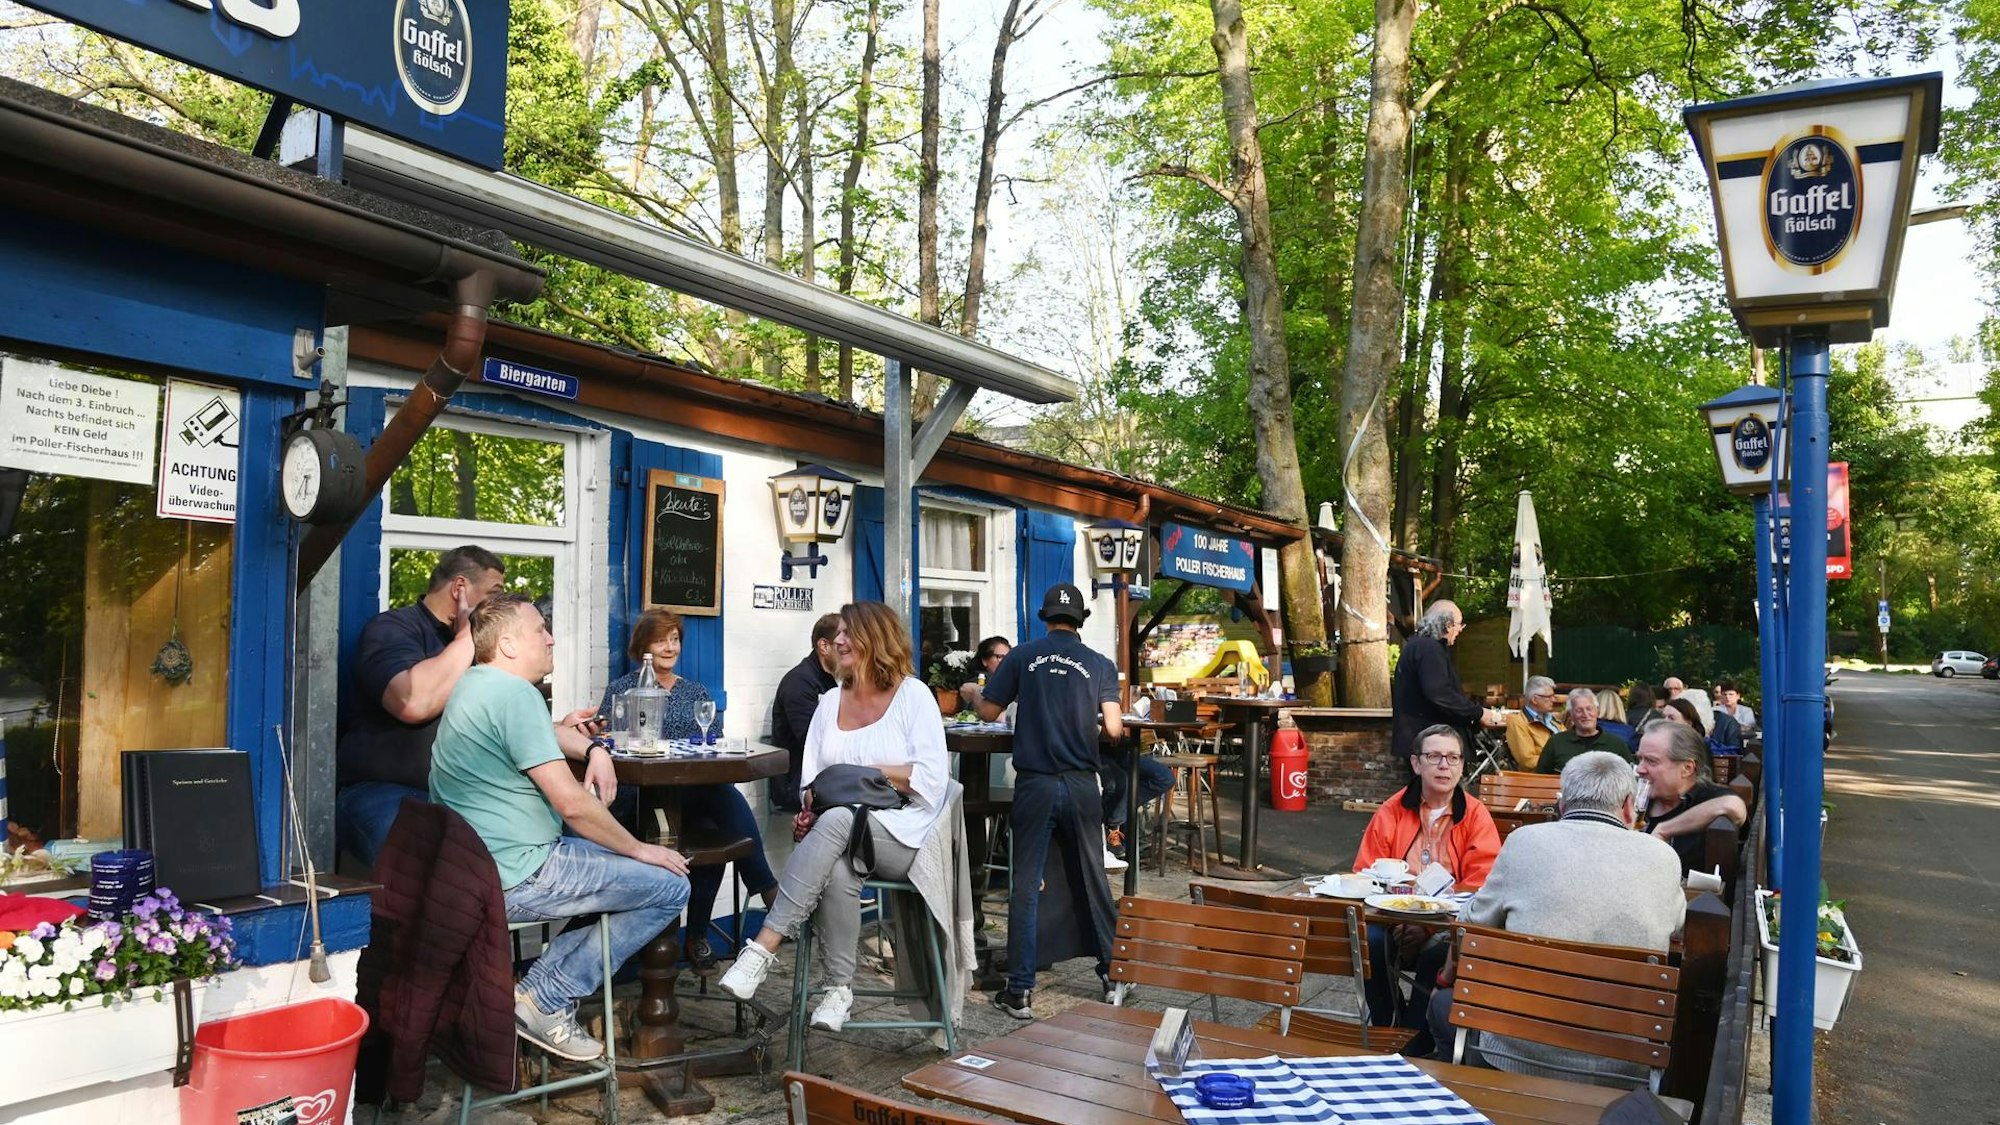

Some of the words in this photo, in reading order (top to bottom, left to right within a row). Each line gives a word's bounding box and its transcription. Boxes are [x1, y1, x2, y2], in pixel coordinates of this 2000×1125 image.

[403, 18, 464, 66] Gaffel
[413, 49, 452, 79] Kölsch
[1770, 182, 1853, 216] Gaffel
[1785, 214, 1836, 233] Kölsch
[500, 363, 566, 392] Biergarten
[50, 378, 78, 391] Liebe
[81, 384, 112, 398] Diebe
[17, 388, 45, 401] Nach
[48, 394, 73, 406] dem
[76, 398, 86, 408] 3.
[89, 400, 134, 416] Einbruch
[26, 405, 64, 420] Nachts
[67, 411, 112, 427] befindet
[115, 418, 135, 430] sich
[54, 425, 80, 437] KEIN
[83, 430, 108, 441] Geld
[12, 434, 26, 444] im
[30, 436, 129, 459] Poller-Fischerhaus
[132, 450, 144, 461] !!!
[1735, 436, 1769, 451] Gaffel
[171, 462, 236, 482] ACHTUNG
[189, 484, 223, 497] Video-
[168, 495, 235, 512] überwachun
[1193, 533, 1207, 550] 100
[1209, 537, 1229, 553] JAHRE
[1175, 557, 1200, 575] POLLER
[1202, 561, 1246, 582] FISCHERHAUS
[774, 587, 811, 601] POLLER
[1059, 590, 1071, 604] LA
